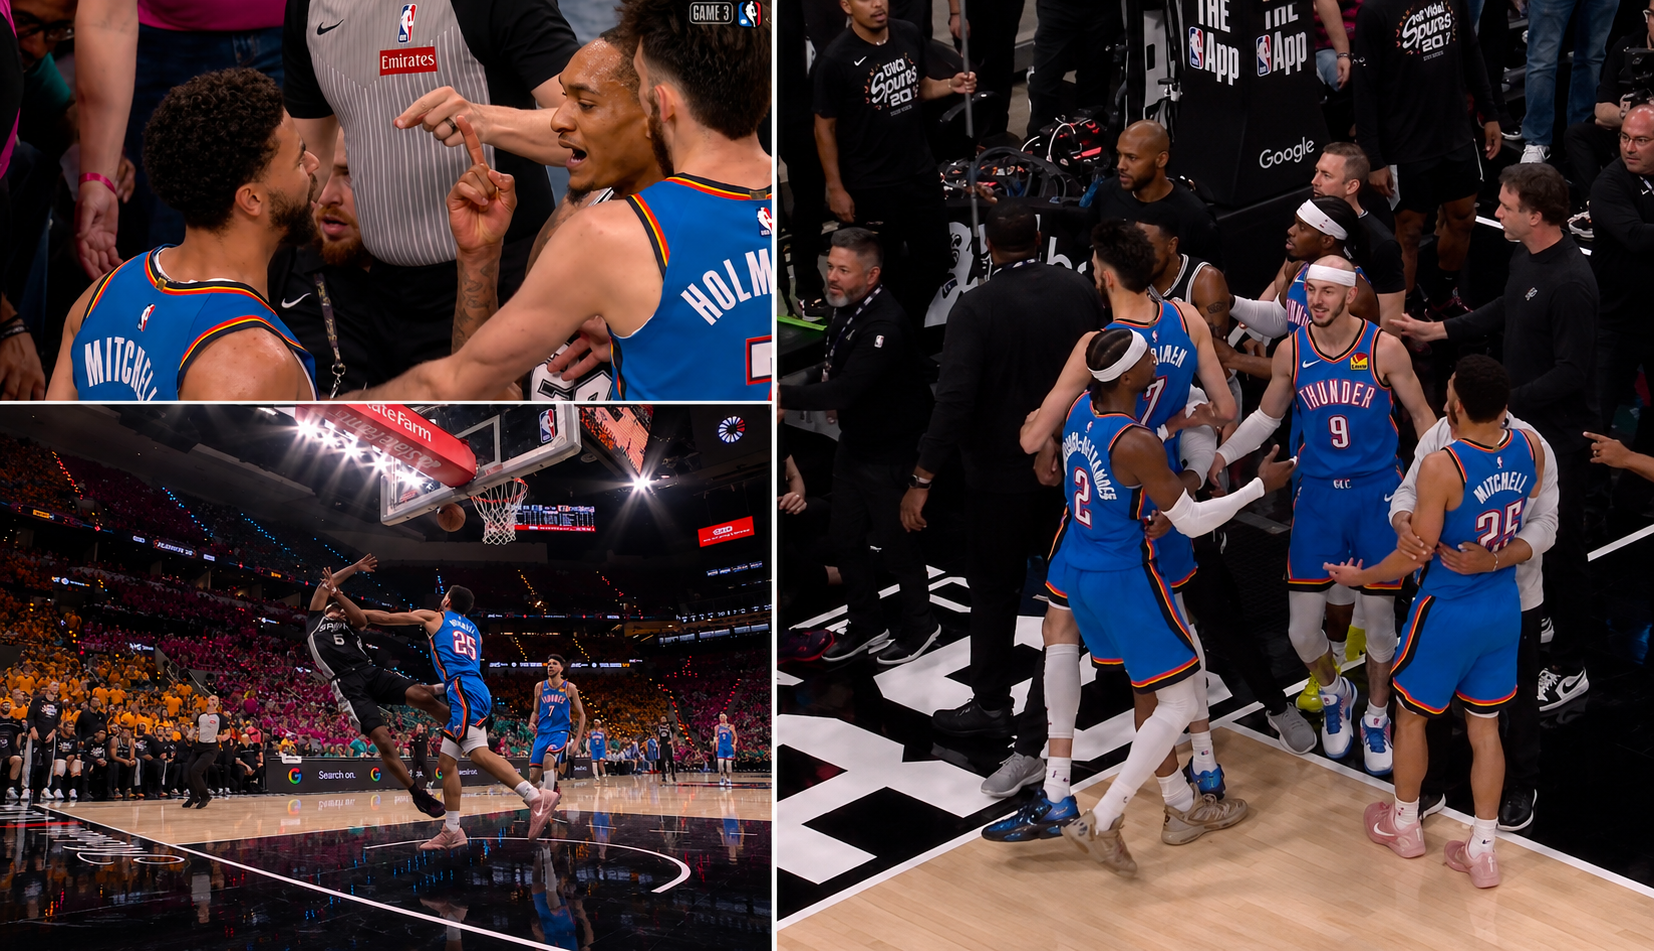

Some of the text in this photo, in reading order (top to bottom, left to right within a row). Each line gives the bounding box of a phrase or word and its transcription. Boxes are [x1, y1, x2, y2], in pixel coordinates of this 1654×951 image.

[382, 54, 435, 70] Emirates
[1205, 31, 1240, 86] App
[1273, 30, 1308, 76] App
[1259, 137, 1315, 169] Google
[1140, 375, 1168, 427] 7
[1299, 379, 1376, 411] THUNDER
[1328, 414, 1351, 450] 9
[1073, 466, 1093, 530] 2
[1473, 471, 1528, 504] MITCHELL
[453, 629, 477, 661] 25
[548, 705, 556, 717] 7
[318, 770, 344, 780] Search
